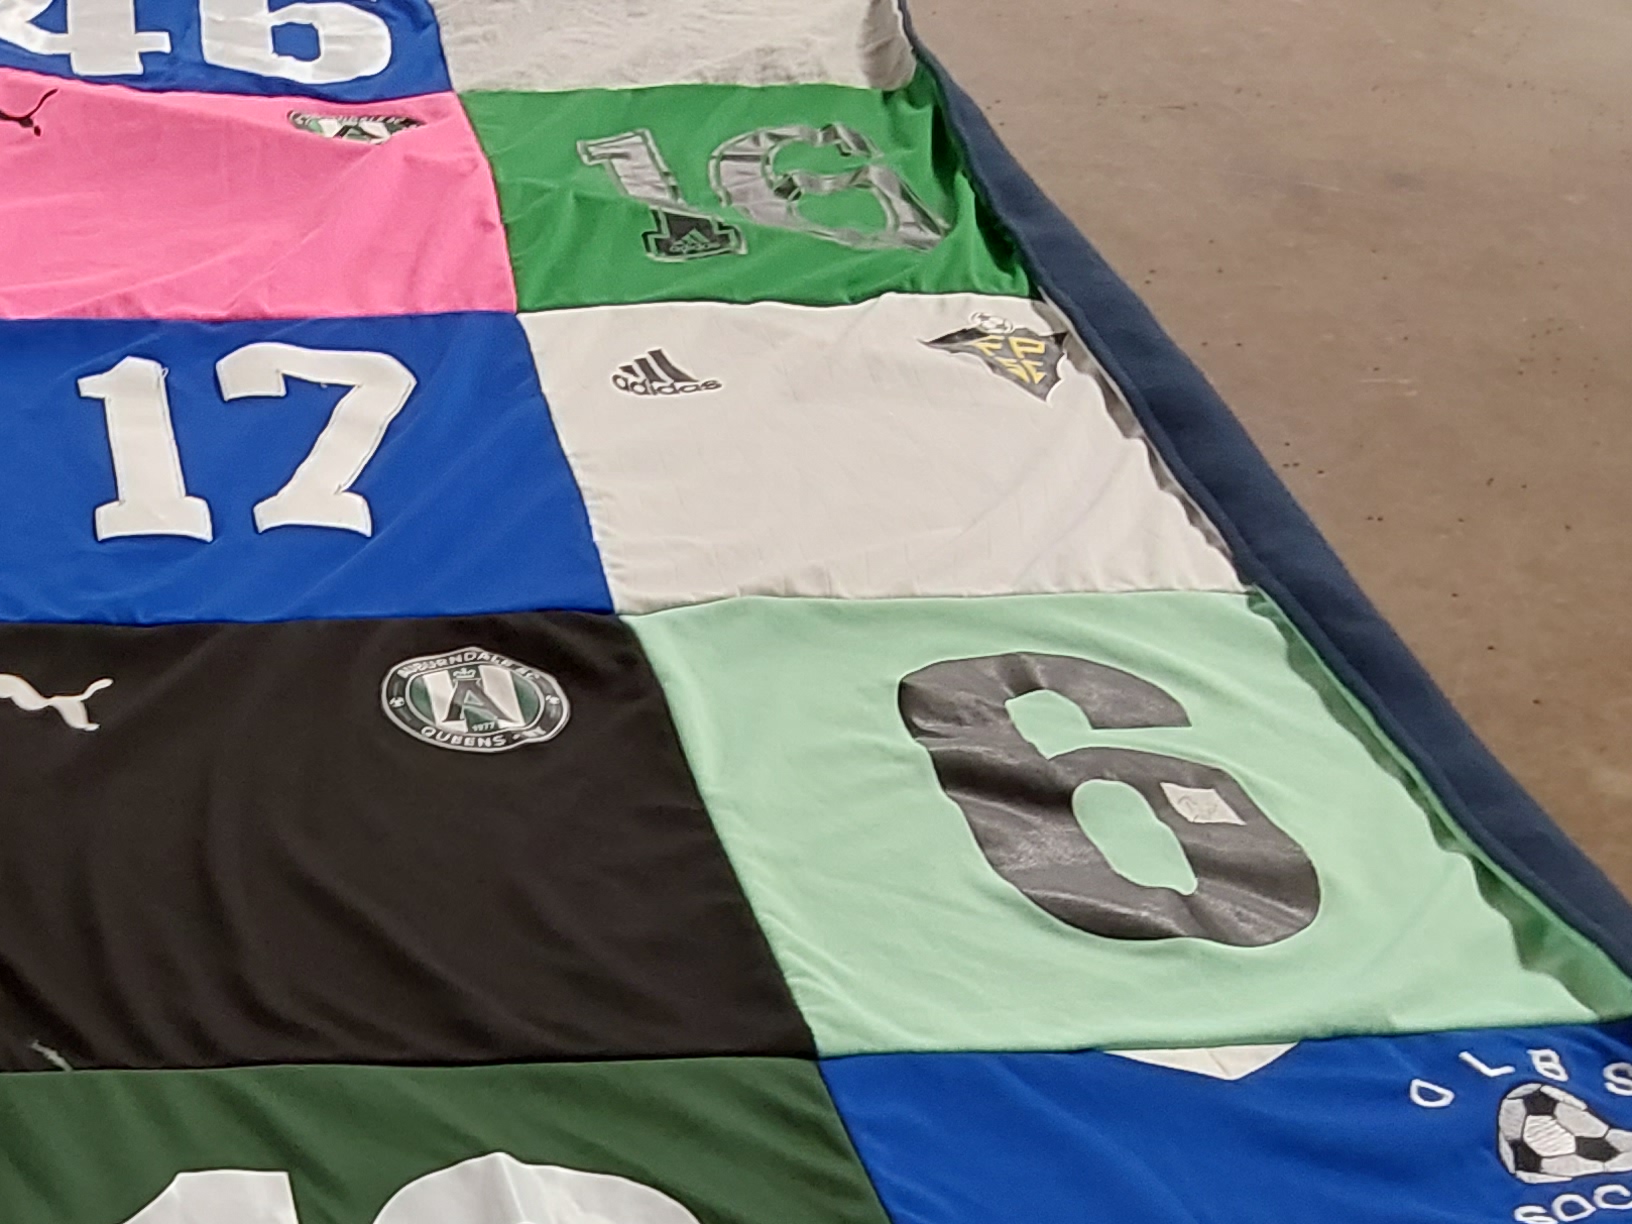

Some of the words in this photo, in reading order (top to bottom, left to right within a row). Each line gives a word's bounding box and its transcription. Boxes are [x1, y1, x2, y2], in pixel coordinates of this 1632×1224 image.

[576, 122, 952, 262] 16
[77, 341, 417, 543] 17
[611, 373, 723, 396] adidas
[420, 725, 507, 748] QUEENS
[896, 650, 1322, 949] 6
